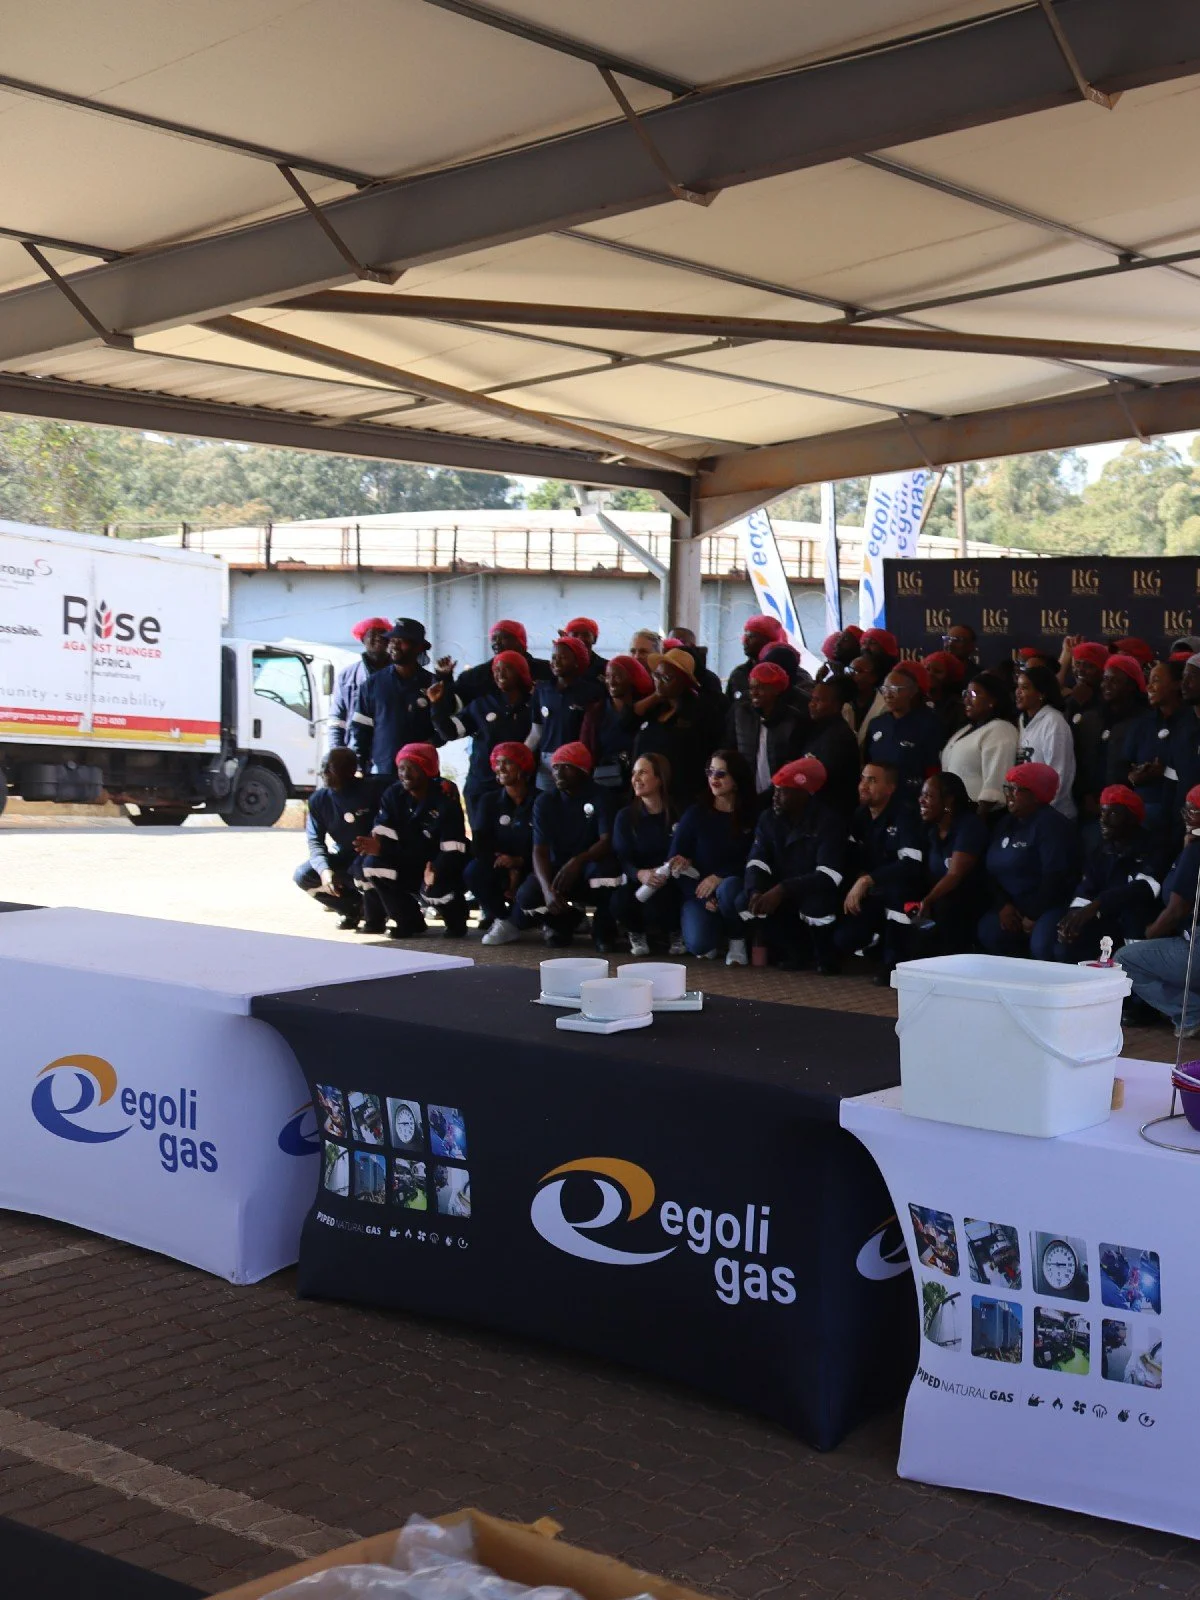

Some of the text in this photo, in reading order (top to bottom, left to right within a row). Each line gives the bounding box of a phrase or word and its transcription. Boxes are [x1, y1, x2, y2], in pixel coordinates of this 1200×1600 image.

[868, 488, 891, 556] egoli
[0, 564, 35, 580] roup
[897, 570, 923, 589] RG
[953, 569, 980, 588] RG
[1012, 569, 1038, 588] RG
[1072, 569, 1099, 588] RG
[1133, 569, 1161, 589] RG
[63, 594, 161, 645] Rise
[926, 608, 952, 627] RG
[983, 608, 1009, 627] RG
[1041, 609, 1069, 628] RG
[1101, 609, 1129, 629] RG
[1164, 610, 1192, 629] RG
[63, 640, 162, 659] AGANST HUNGER
[94, 657, 132, 669] AFRICA
[121, 1087, 197, 1130] egoli
[159, 1132, 219, 1173] gas
[365, 1225, 381, 1235] GAS
[660, 1201, 770, 1255] egoli
[714, 1256, 797, 1305] gas
[941, 1380, 989, 1400] NATURAL
[989, 1390, 1014, 1403] GAS
